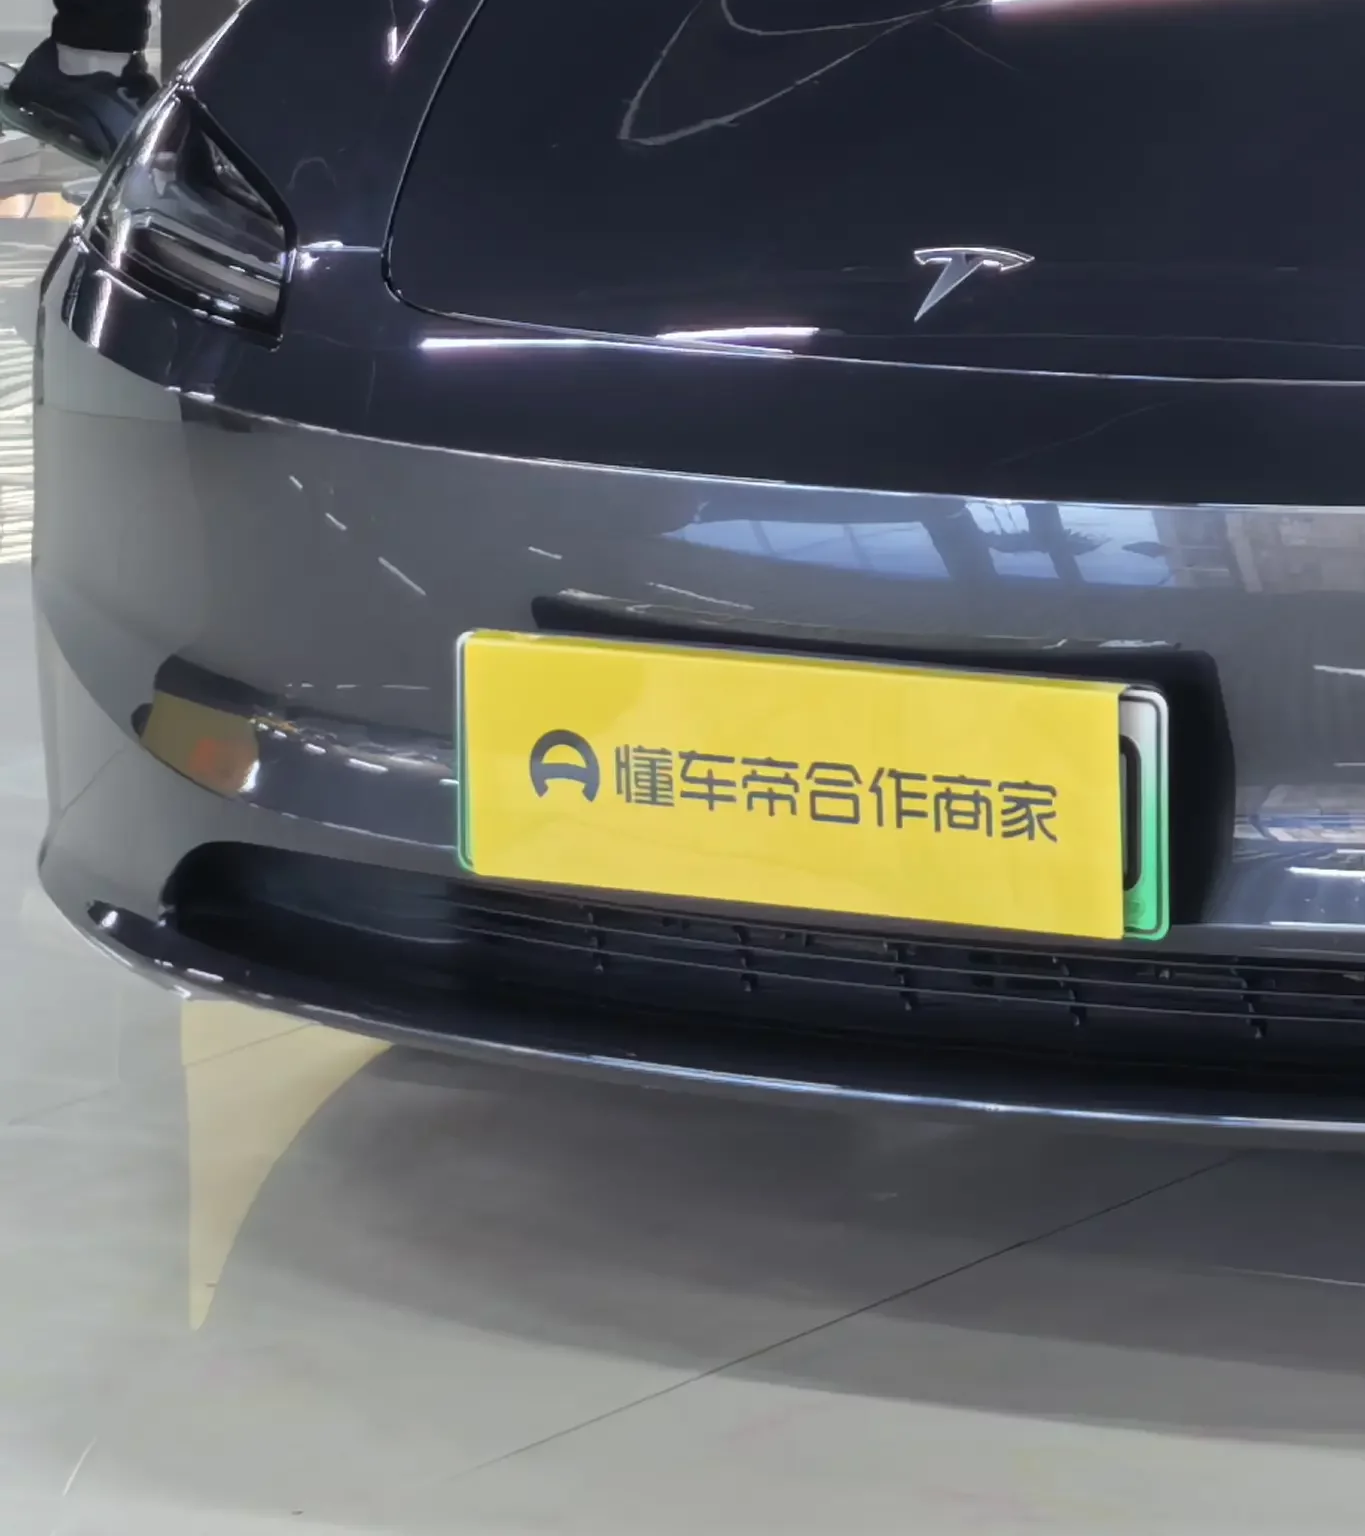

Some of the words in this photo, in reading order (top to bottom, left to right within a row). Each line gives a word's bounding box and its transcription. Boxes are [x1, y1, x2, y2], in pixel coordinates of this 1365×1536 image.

[615, 744, 1058, 843] 懂车帝合作商家
